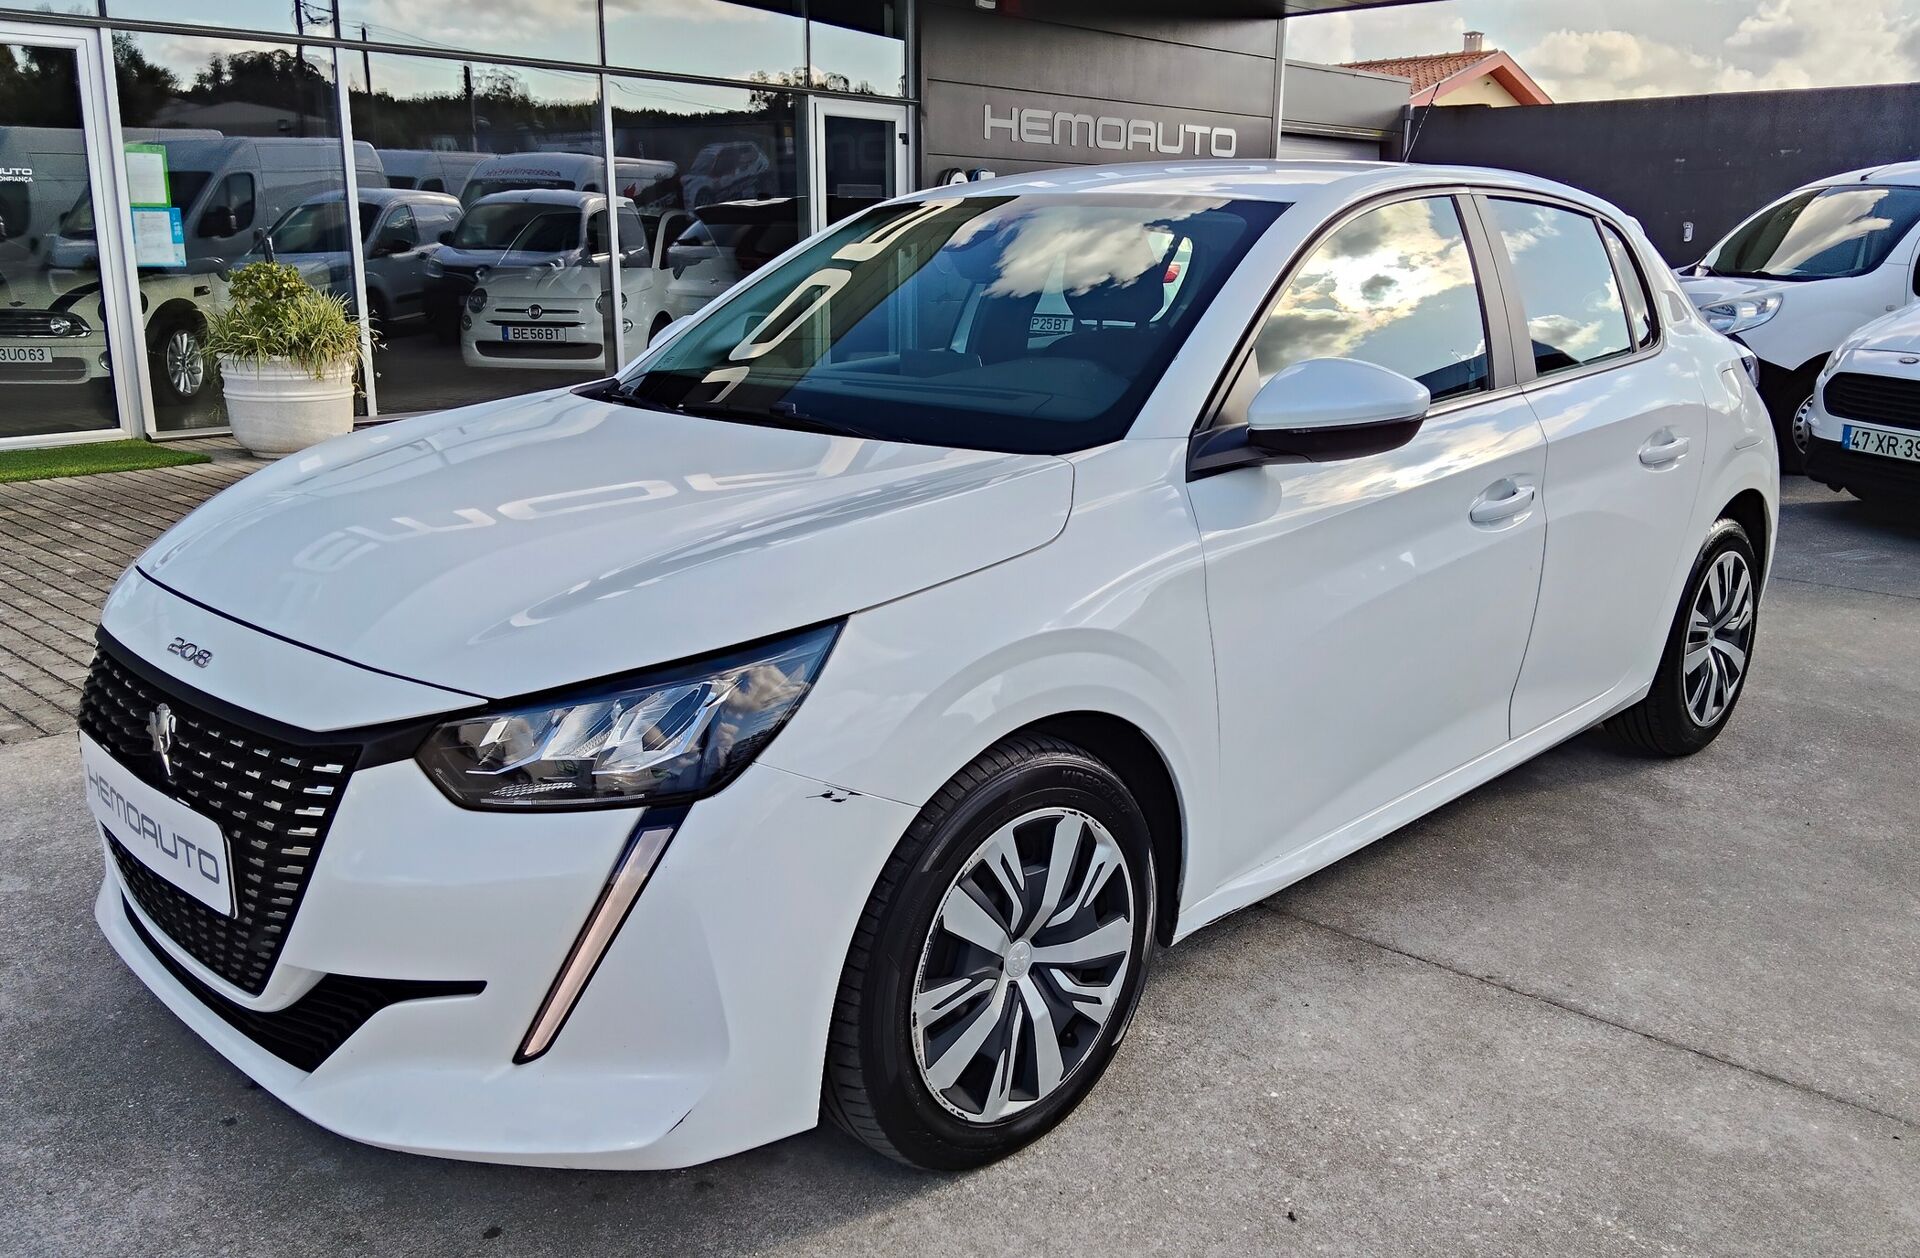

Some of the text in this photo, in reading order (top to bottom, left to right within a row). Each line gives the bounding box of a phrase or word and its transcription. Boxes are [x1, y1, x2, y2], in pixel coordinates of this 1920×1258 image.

[983, 104, 1237, 158] HEMOAUTO
[512, 328, 560, 340] BE56BT
[167, 636, 213, 668] 208
[87, 764, 220, 884] HEMOAUTO
